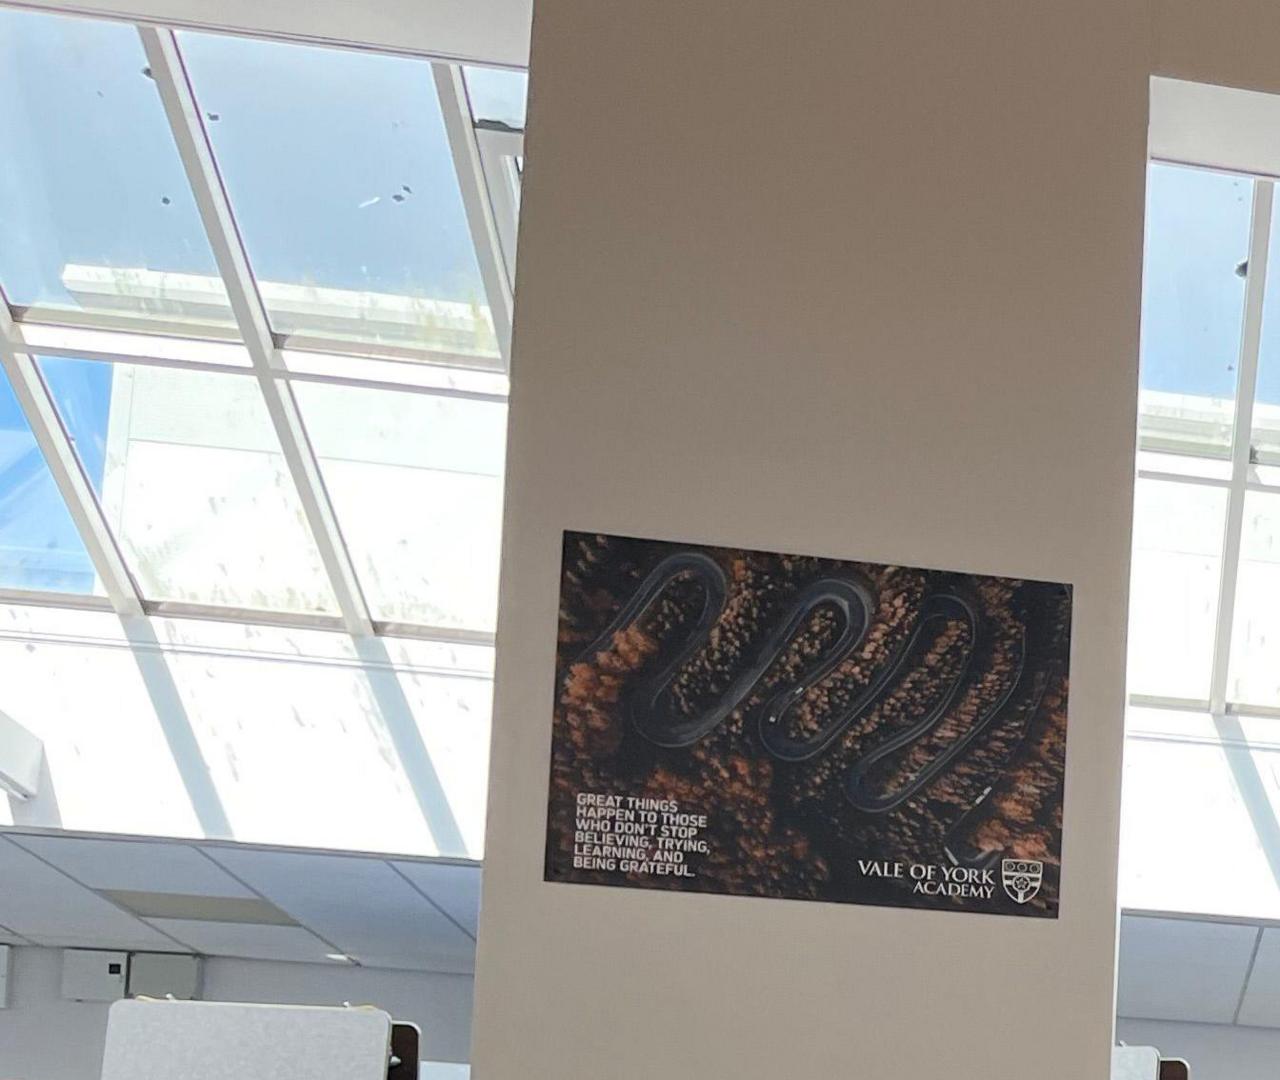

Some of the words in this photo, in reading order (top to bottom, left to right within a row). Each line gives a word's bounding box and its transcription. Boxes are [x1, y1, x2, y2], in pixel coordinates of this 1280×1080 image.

[576, 792, 623, 808] GREAT
[626, 796, 678, 813] THINGS
[576, 805, 635, 822] HAPPEN
[638, 811, 657, 823] TO
[661, 812, 708, 828] THOSE
[575, 818, 611, 832] WHO
[615, 822, 657, 836] DON'T
[660, 825, 697, 839] STOP
[575, 830, 653, 850] BELIEVING,
[656, 837, 711, 855] TRYING,
[574, 843, 649, 862] LEARNING,
[653, 851, 683, 864] AND
[573, 856, 616, 871] BEING
[620, 860, 696, 878] GRATEFUL.
[858, 860, 904, 878] VALE
[909, 864, 937, 880] OF
[941, 866, 996, 885] YORK
[912, 880, 995, 899] ACADEMY
